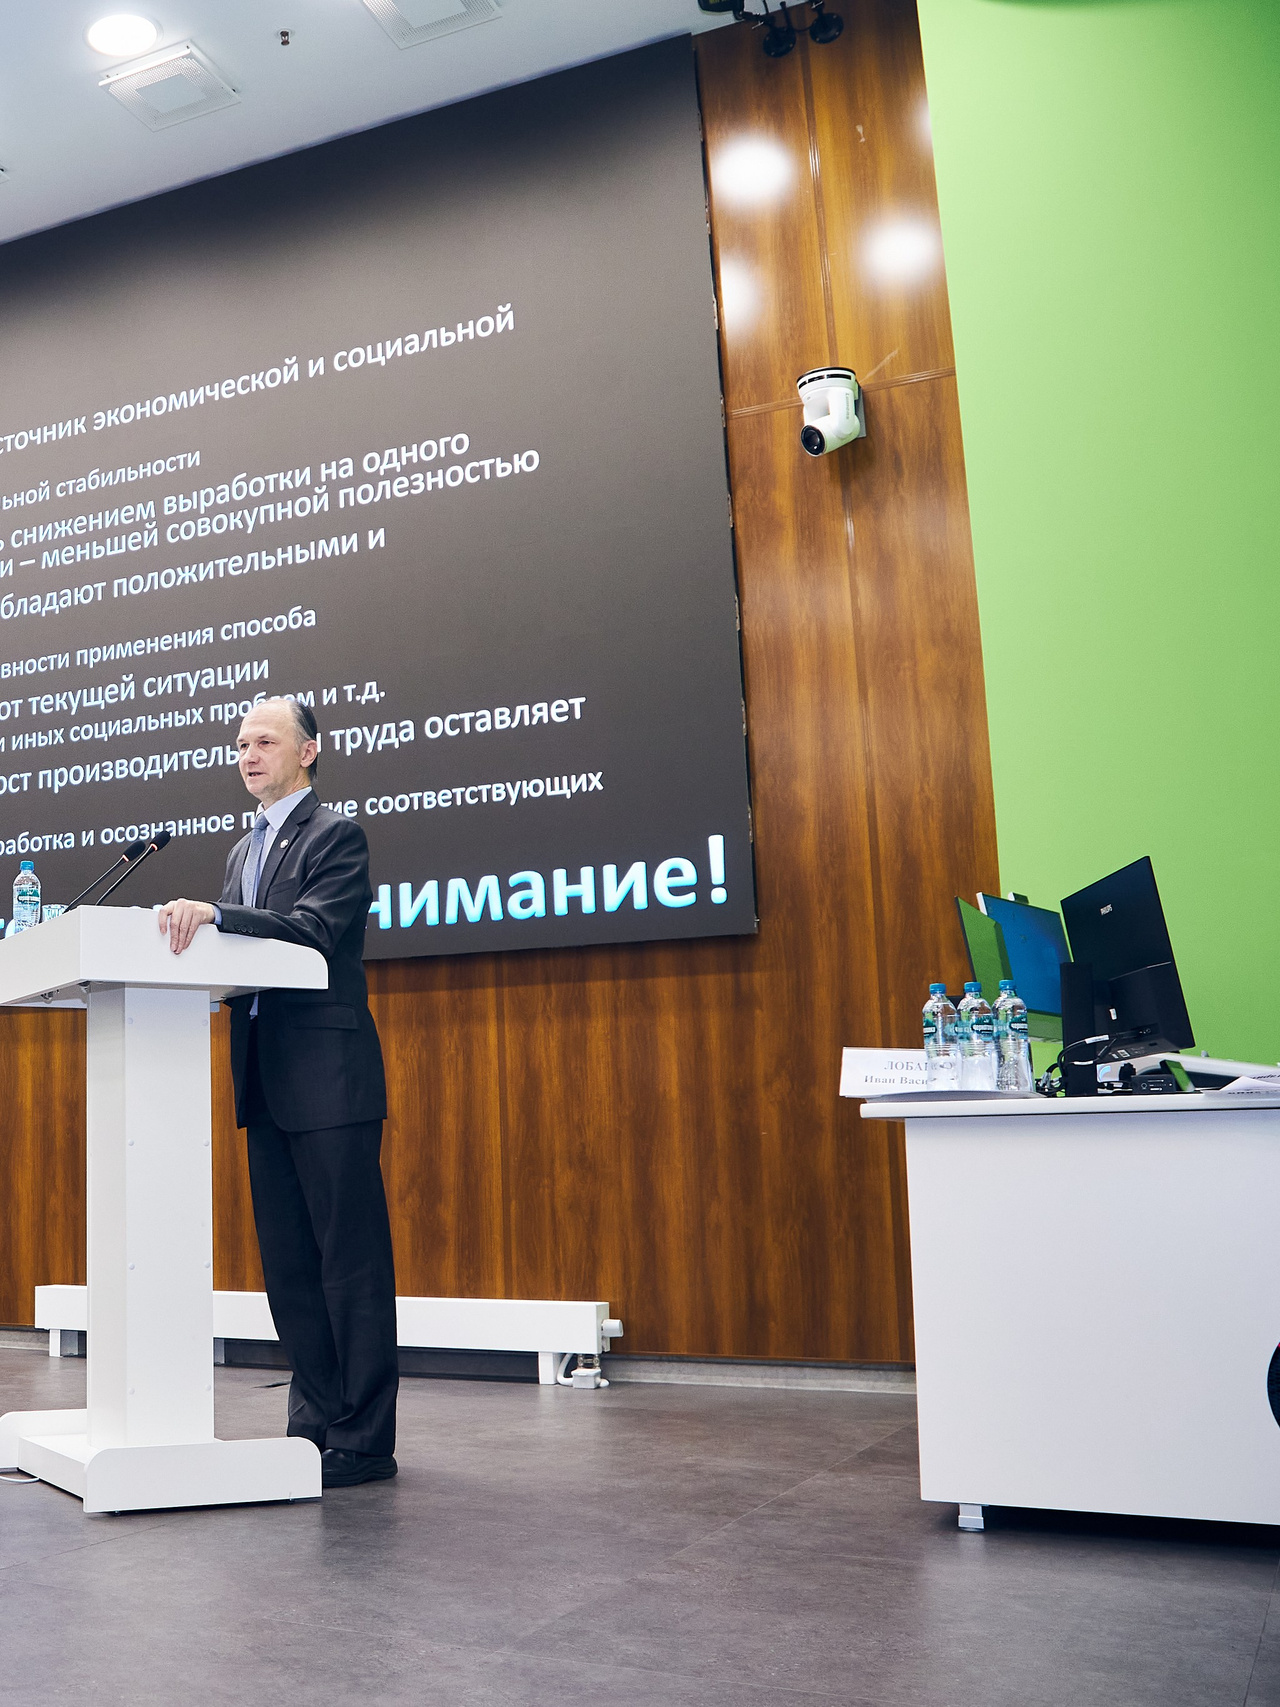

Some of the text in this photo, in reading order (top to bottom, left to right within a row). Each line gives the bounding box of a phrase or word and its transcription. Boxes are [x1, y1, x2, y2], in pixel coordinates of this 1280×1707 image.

[93, 355, 299, 431] экономической
[308, 356, 325, 378] и
[333, 302, 514, 372] социальной
[11, 500, 157, 548] снижением
[163, 466, 311, 516] выработки
[320, 457, 354, 482] на
[362, 433, 470, 476] одного
[41, 527, 158, 570] меньшей
[166, 484, 329, 544] совокупной
[338, 449, 540, 509] полезностью
[56, 450, 200, 498] стабильности
[113, 532, 358, 598] положительными
[368, 527, 385, 550] и
[76, 626, 214, 669] применения
[220, 605, 316, 641] способа
[11, 727, 65, 751] иных
[69, 706, 204, 742] социальных
[322, 687, 337, 706] и
[342, 681, 386, 705] т.д.
[27, 673, 135, 716] текущей
[143, 659, 269, 698] ситуации
[38, 732, 322, 794] производитель
[329, 719, 415, 757] труда
[424, 696, 587, 739] оставляет
[81, 829, 95, 847] и
[100, 813, 235, 845] осознанное
[364, 771, 604, 816] соответствующих
[367, 834, 728, 931] нимание!
[863, 1075, 928, 1085] Иван Васи
